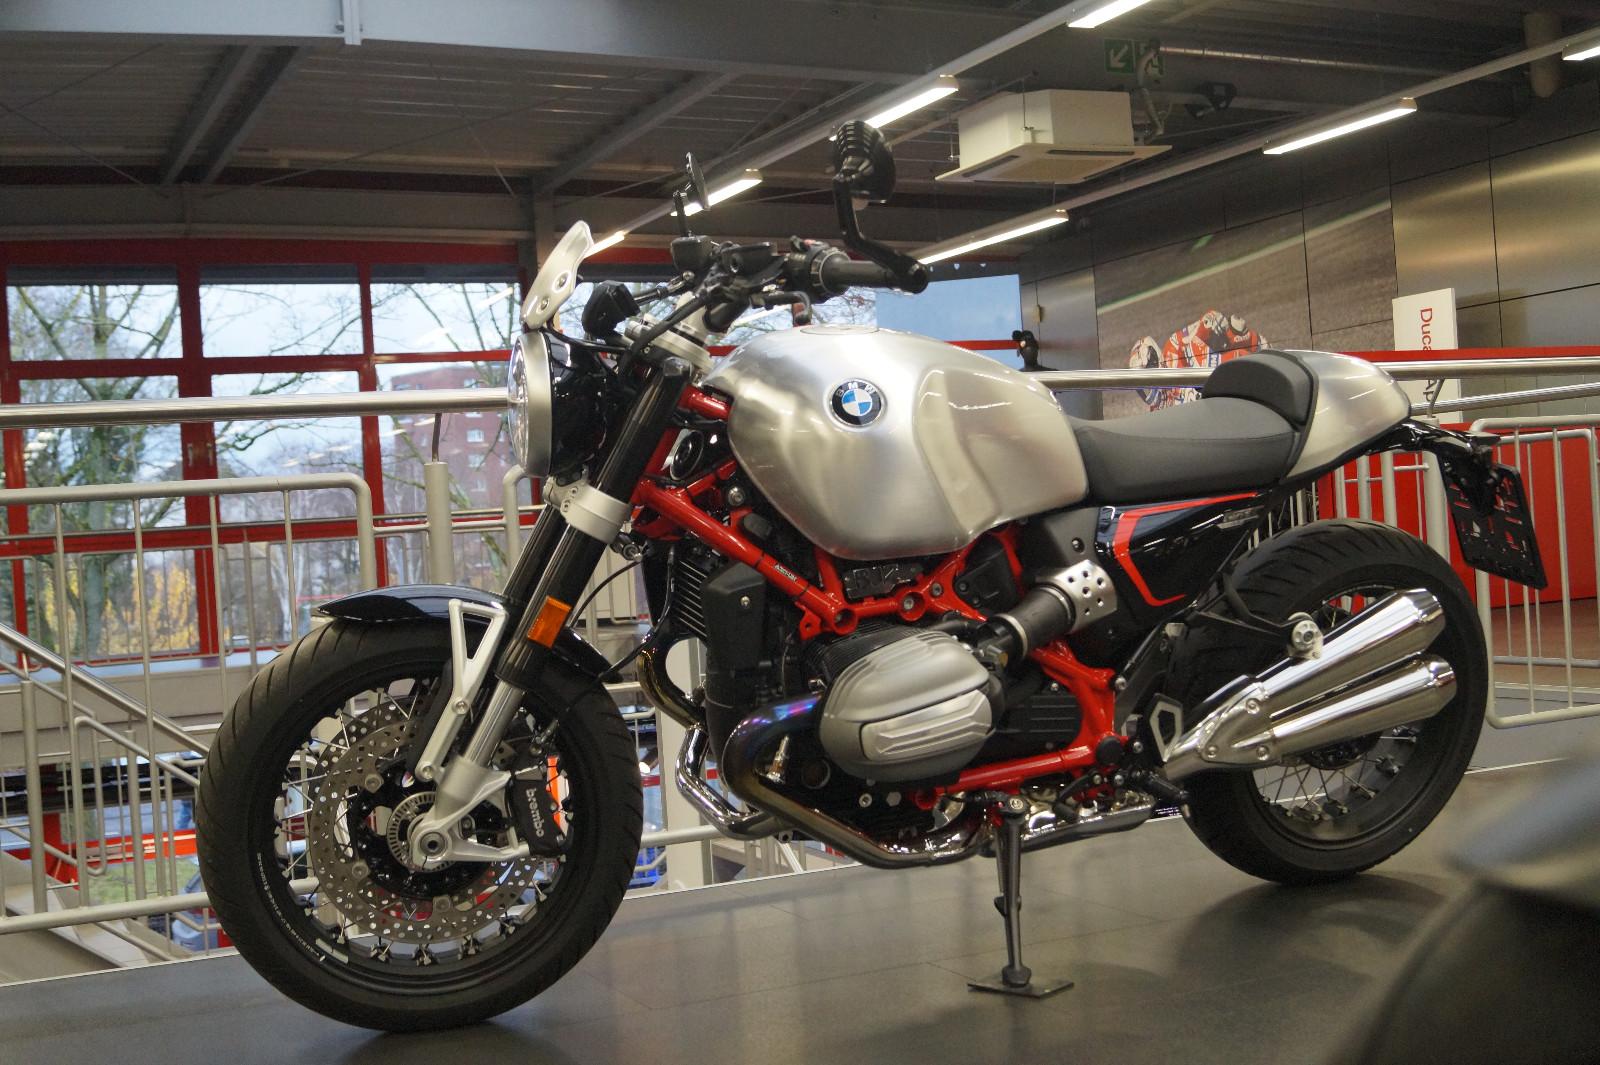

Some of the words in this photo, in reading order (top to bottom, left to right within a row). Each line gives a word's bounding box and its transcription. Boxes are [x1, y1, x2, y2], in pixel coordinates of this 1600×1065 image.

[1420, 308, 1433, 351] Duca
[836, 382, 877, 397] BMW
[526, 788, 544, 837] brembo
